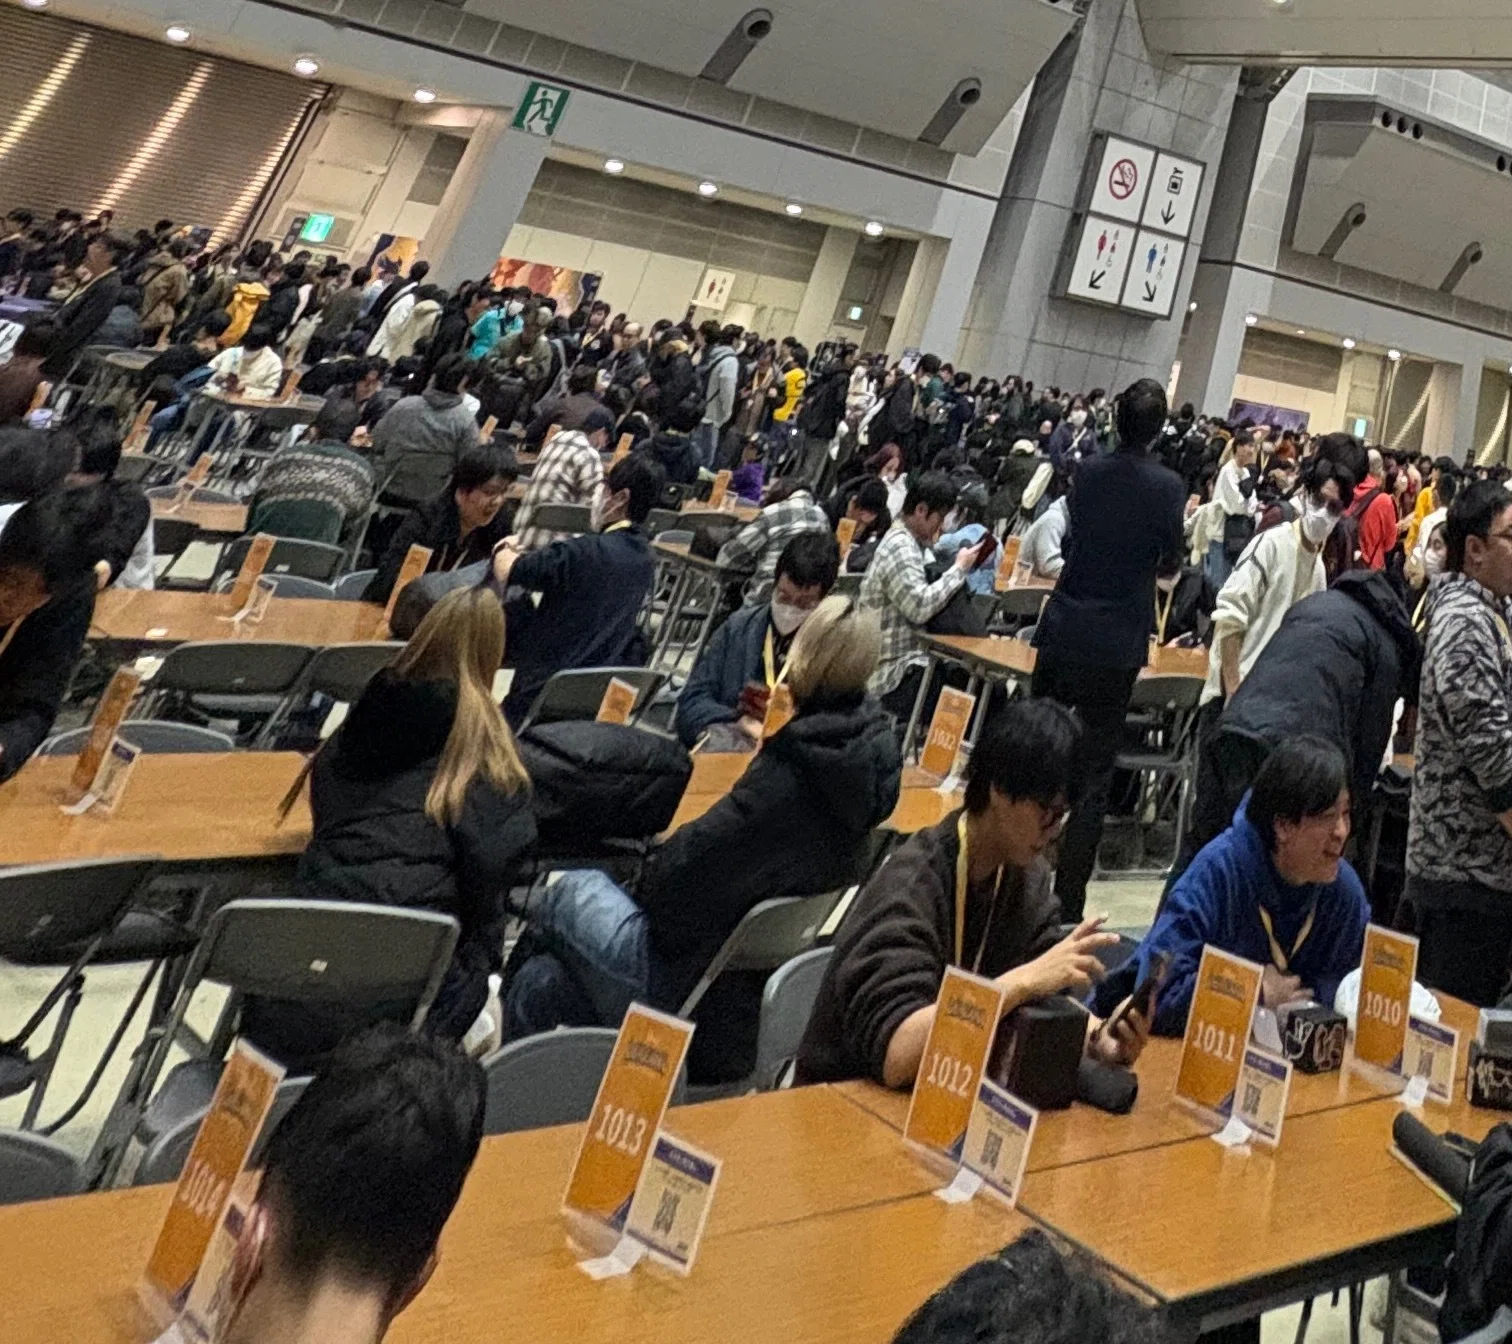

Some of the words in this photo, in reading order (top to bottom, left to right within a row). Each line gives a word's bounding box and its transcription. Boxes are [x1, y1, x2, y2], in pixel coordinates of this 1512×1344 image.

[1365, 991, 1401, 1027] 1010
[1193, 1020, 1236, 1062] 1011
[926, 1052, 974, 1098] 1012
[595, 1103, 648, 1156] 1013
